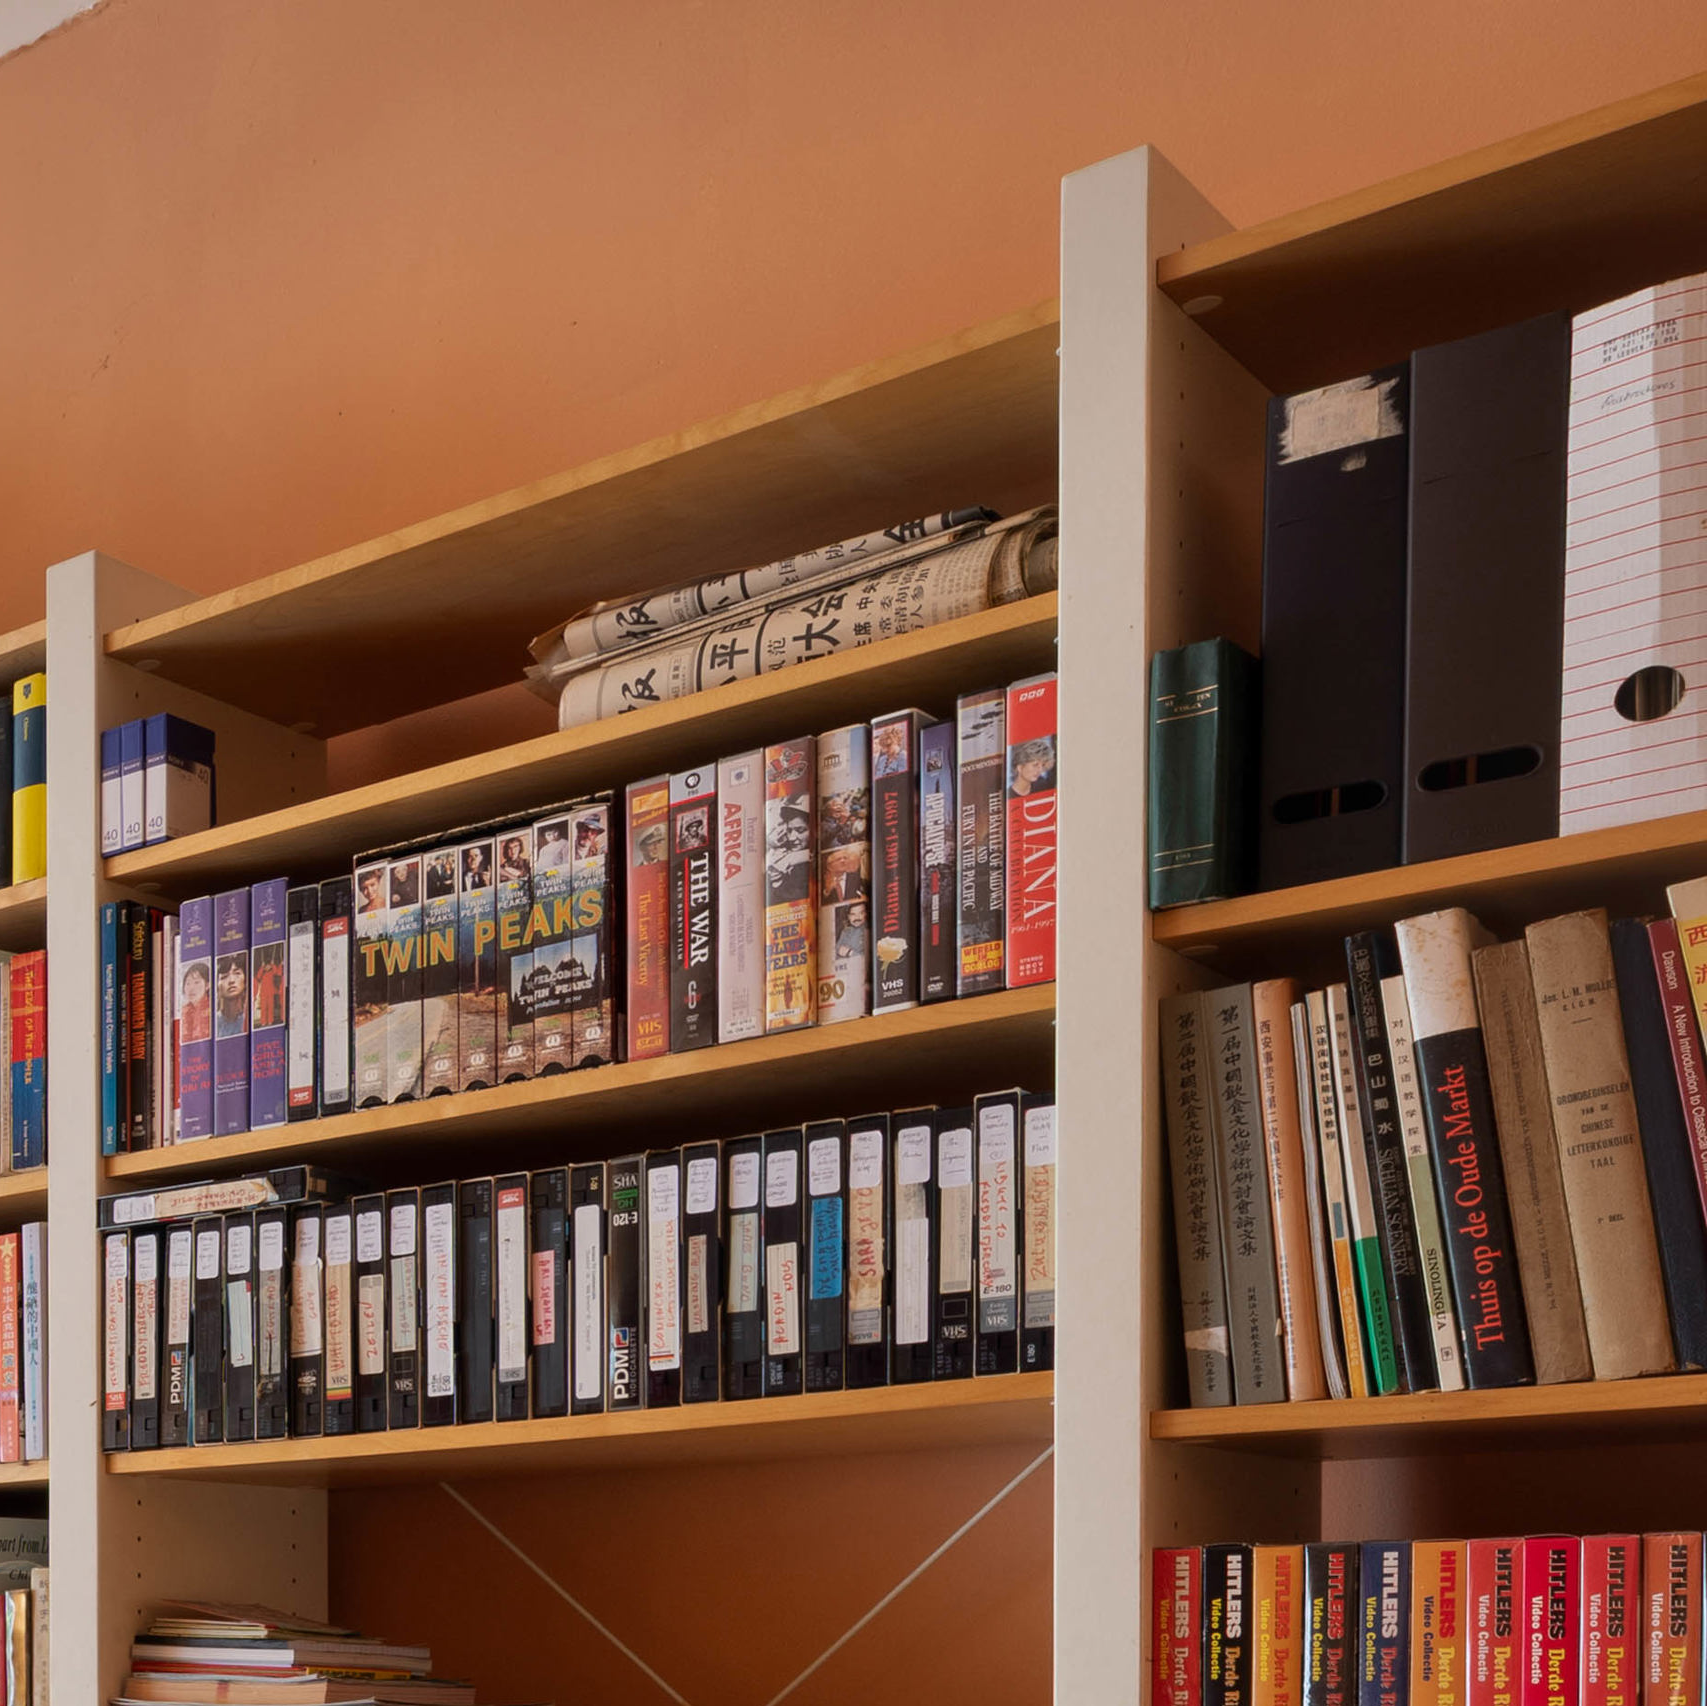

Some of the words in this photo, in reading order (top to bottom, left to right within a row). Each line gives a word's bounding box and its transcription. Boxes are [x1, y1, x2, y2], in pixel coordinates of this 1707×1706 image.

[102, 829, 119, 842] 40
[125, 822, 141, 835] 40
[147, 814, 163, 829] 40
[723, 803, 742, 881] AFRICA
[689, 852, 709, 908] THE
[1023, 793, 1057, 922] DIANA
[360, 928, 456, 977] TWIN
[474, 889, 604, 957] PEAKS
[689, 911, 709, 968] WAR
[819, 980, 845, 1005] 90
[1661, 950, 1679, 990] Dawson
[1440, 1064, 1476, 1139] Markt
[613, 1173, 637, 1189] VHS
[1451, 1141, 1483, 1207] Oude
[613, 1211, 639, 1226] E-120
[1460, 1209, 1488, 1243] de
[1474, 1246, 1502, 1275] op
[1427, 1247, 1447, 1332] SINOLINGUA
[1472, 1278, 1504, 1350] Thuis
[170, 1366, 180, 1404] PDM
[614, 1349, 629, 1400] PDM
[1210, 1597, 1222, 1629] Video
[1227, 1554, 1241, 1640] HITLERS
[1328, 1553, 1344, 1640] HITLERS
[1382, 1551, 1398, 1640] HITLERS
[1439, 1549, 1456, 1639] HITLERS
[1495, 1547, 1512, 1639] HITLERS
[1531, 1595, 1543, 1630] Video
[1549, 1548, 1566, 1640] HITLERS
[1607, 1545, 1625, 1639] HITLERS
[1209, 1632, 1222, 1681] Collectie
[1531, 1632, 1543, 1684] Collectie
[1548, 1648, 1565, 1691] Derde
